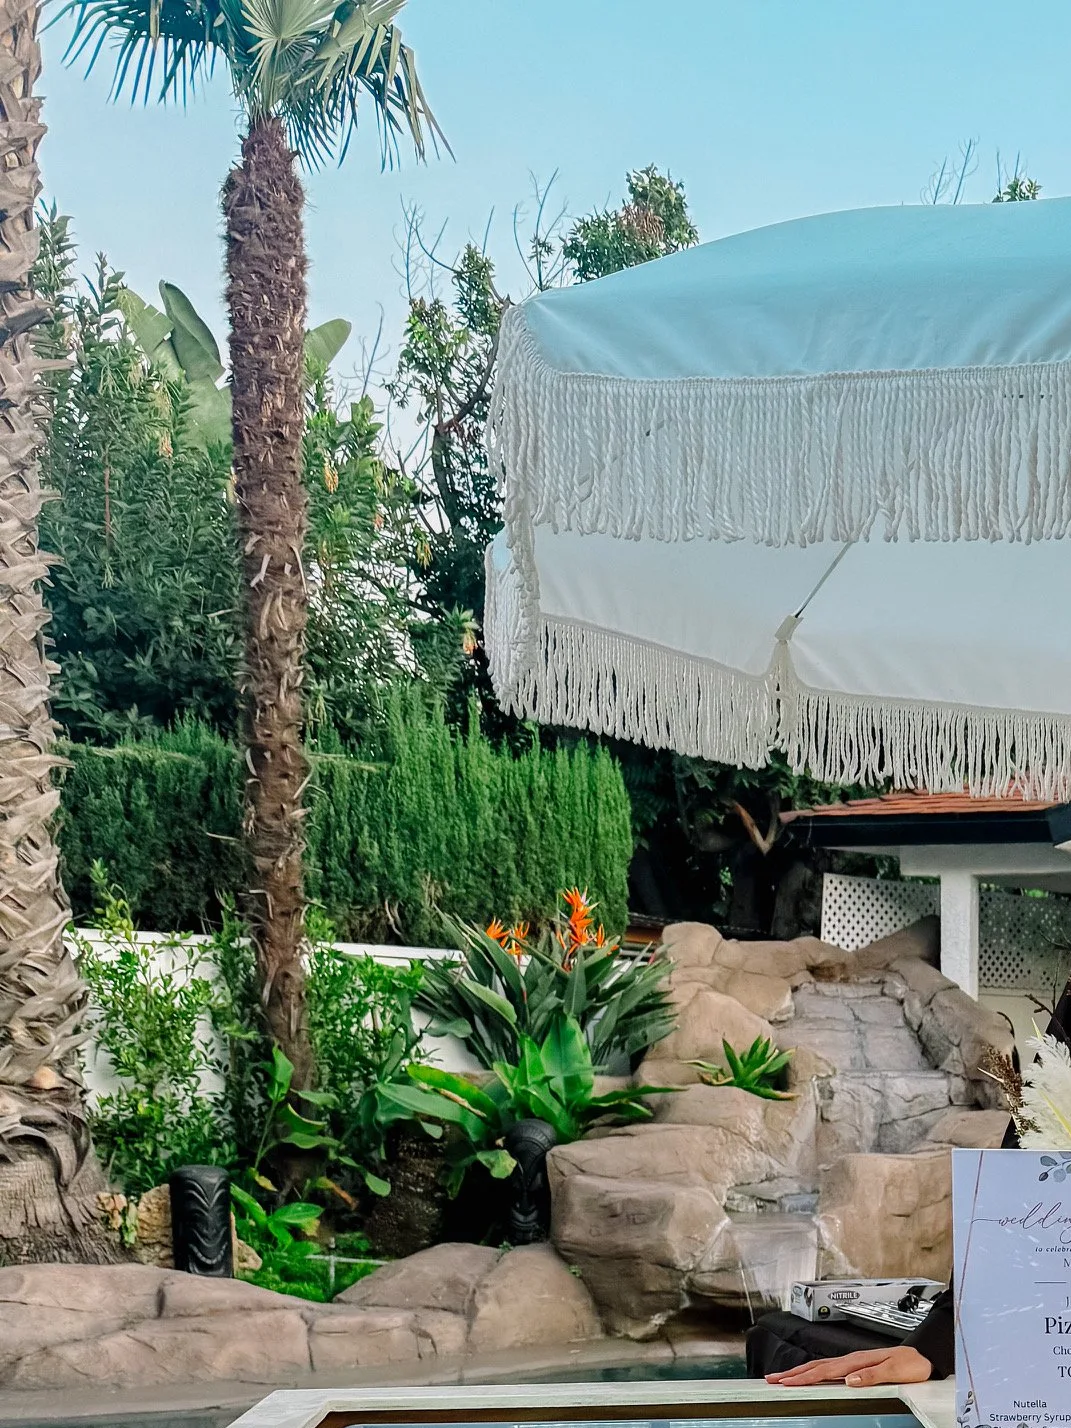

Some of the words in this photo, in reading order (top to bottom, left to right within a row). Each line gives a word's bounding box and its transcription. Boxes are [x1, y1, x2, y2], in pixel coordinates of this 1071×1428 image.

[1013, 1399, 1048, 1409] Nutella
[989, 1413, 1042, 1424] Strawberry
[1044, 1413, 1071, 1424] Syrup
